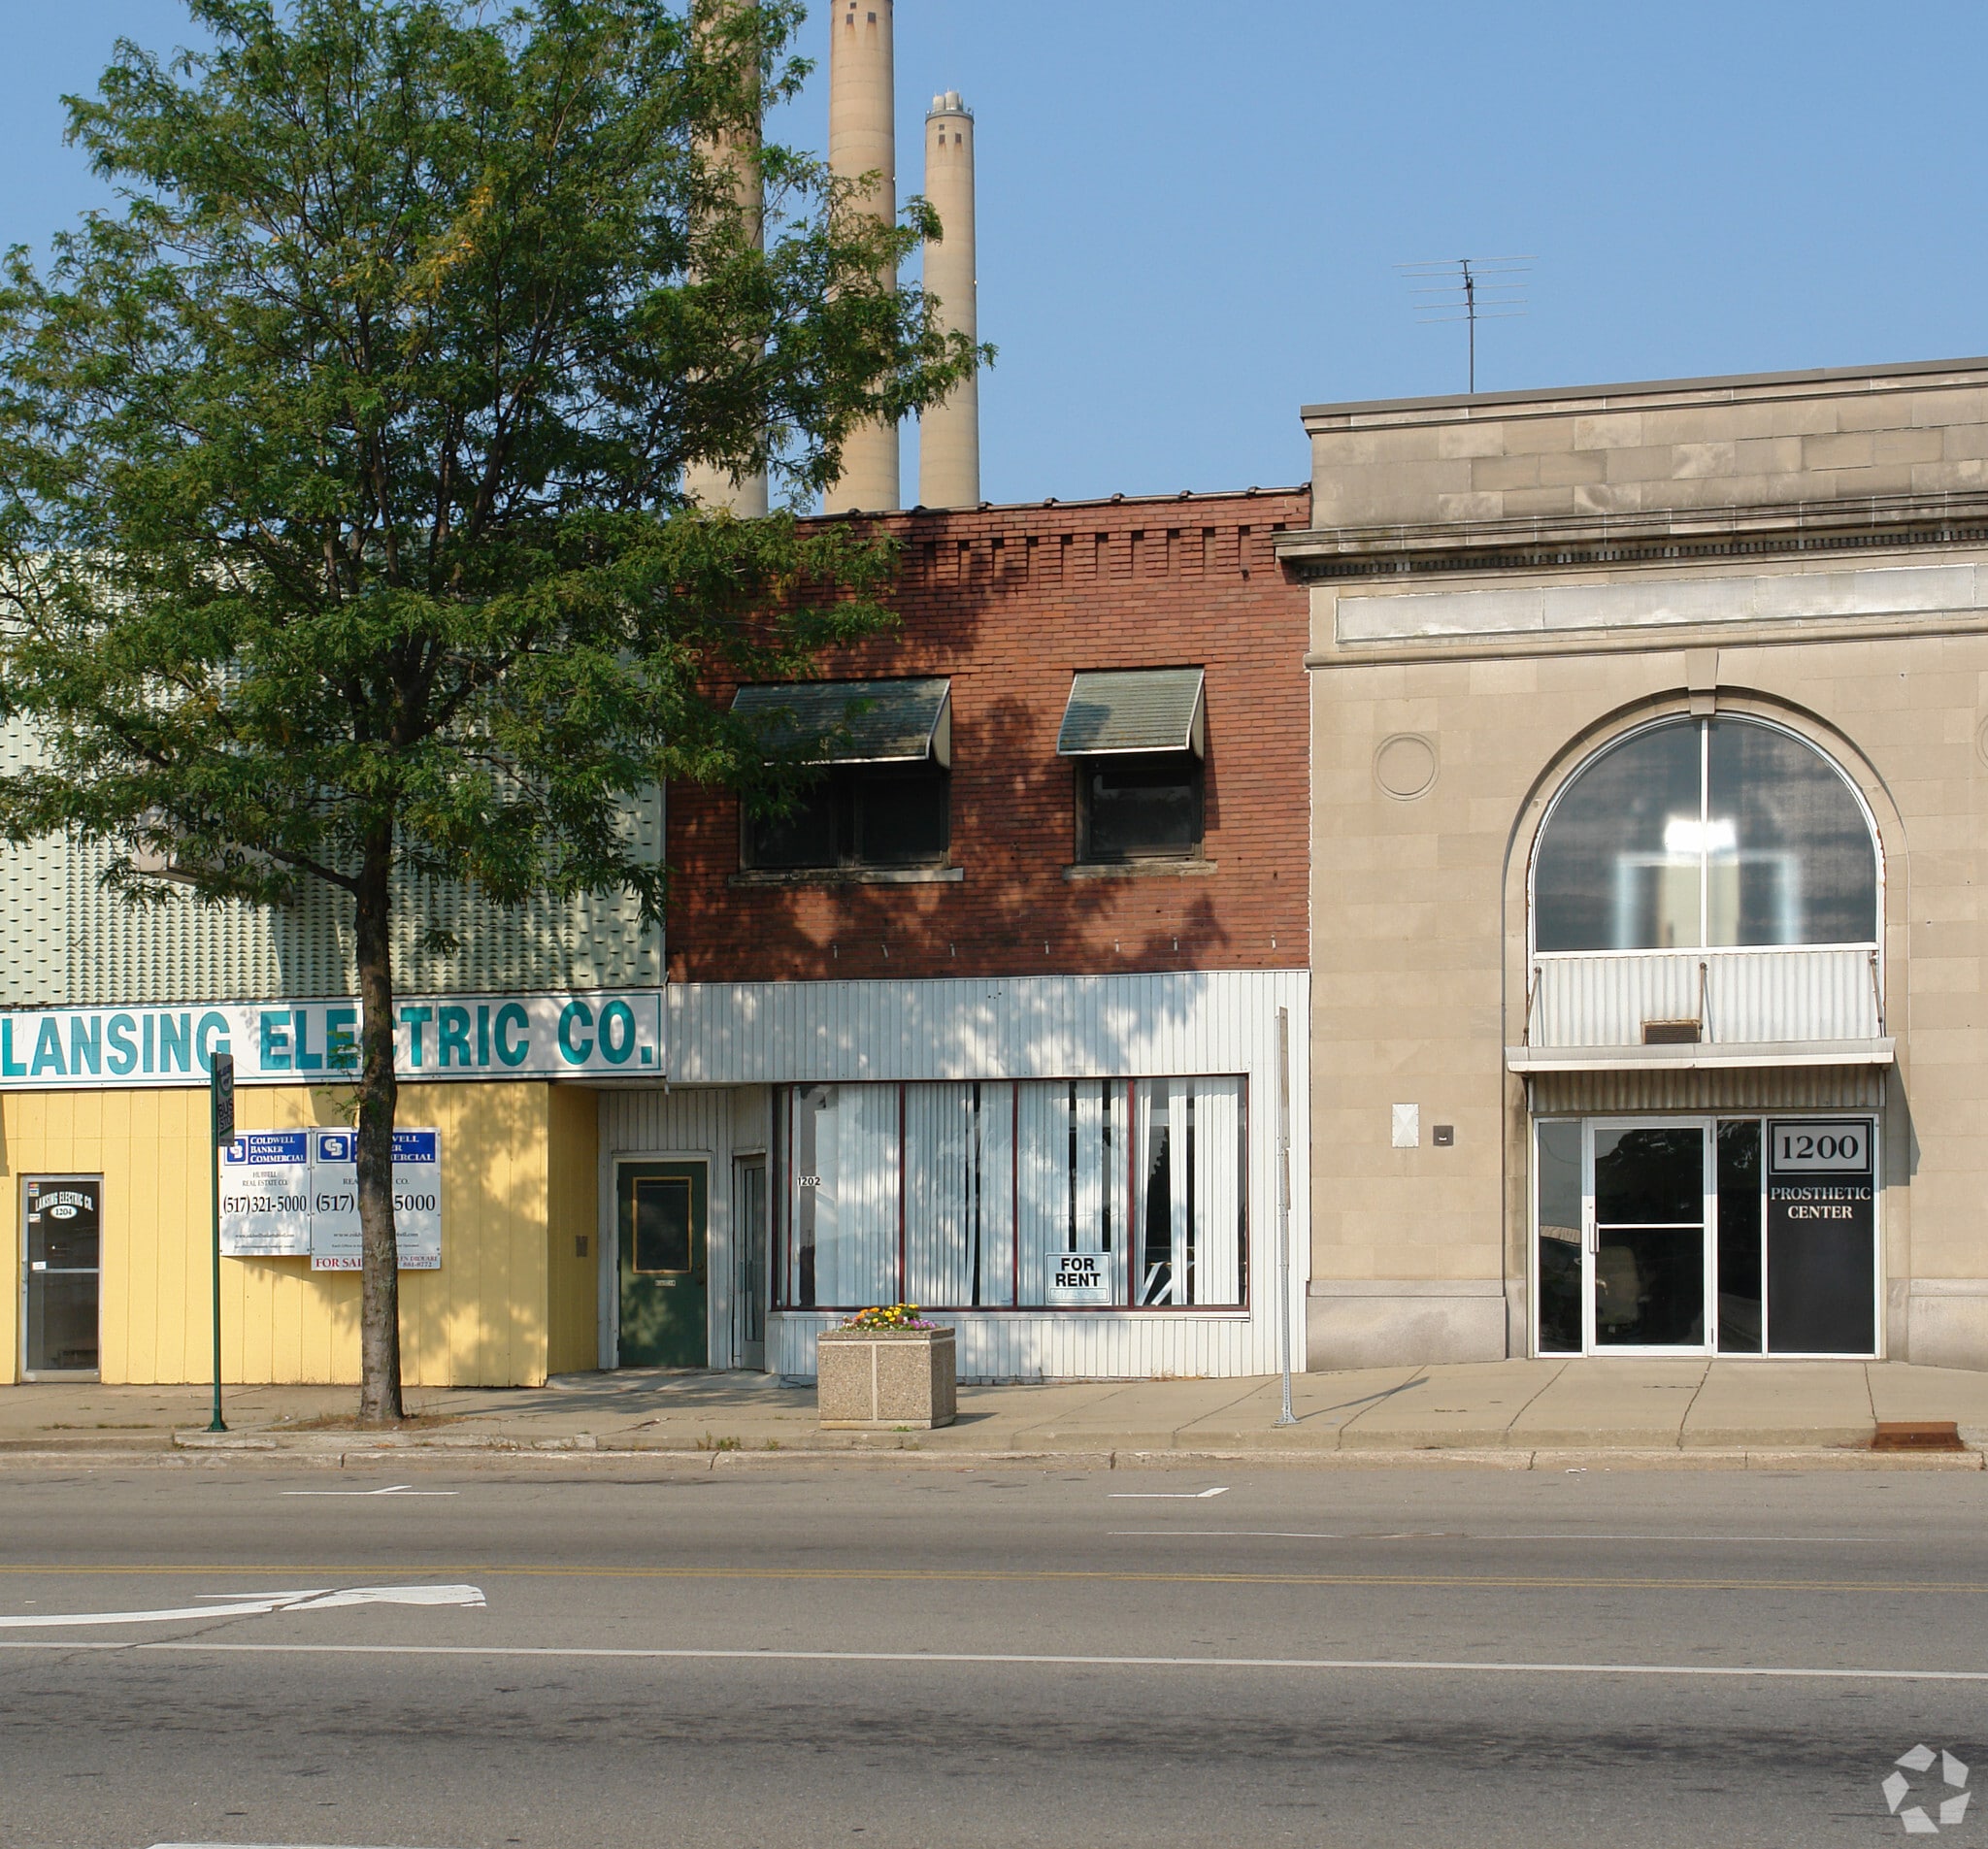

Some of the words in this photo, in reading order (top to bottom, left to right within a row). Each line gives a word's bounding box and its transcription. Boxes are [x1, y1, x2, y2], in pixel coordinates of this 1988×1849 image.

[2, 1010, 231, 1076] LANSING
[260, 1002, 530, 1071] ELETRIC
[558, 1000, 654, 1069] CO.
[218, 1098, 233, 1118] BUS
[249, 1136, 295, 1145] COLDWELL
[1783, 1135, 1859, 1160] 1200
[249, 1145, 283, 1154] BANKER
[249, 1154, 306, 1163] COMMERCIAL
[798, 1176, 821, 1186] 1202
[1771, 1186, 1872, 1202] PROSTHETIC
[35, 1192, 58, 1212] LANSING
[58, 1191, 83, 1207] ELECTRIC
[55, 1207, 73, 1216] 1204
[1787, 1205, 1854, 1220] CENTER
[315, 1258, 341, 1268] FOR
[342, 1258, 363, 1268] SAL
[1061, 1257, 1095, 1271] FOR
[1055, 1272, 1101, 1287] RENT
